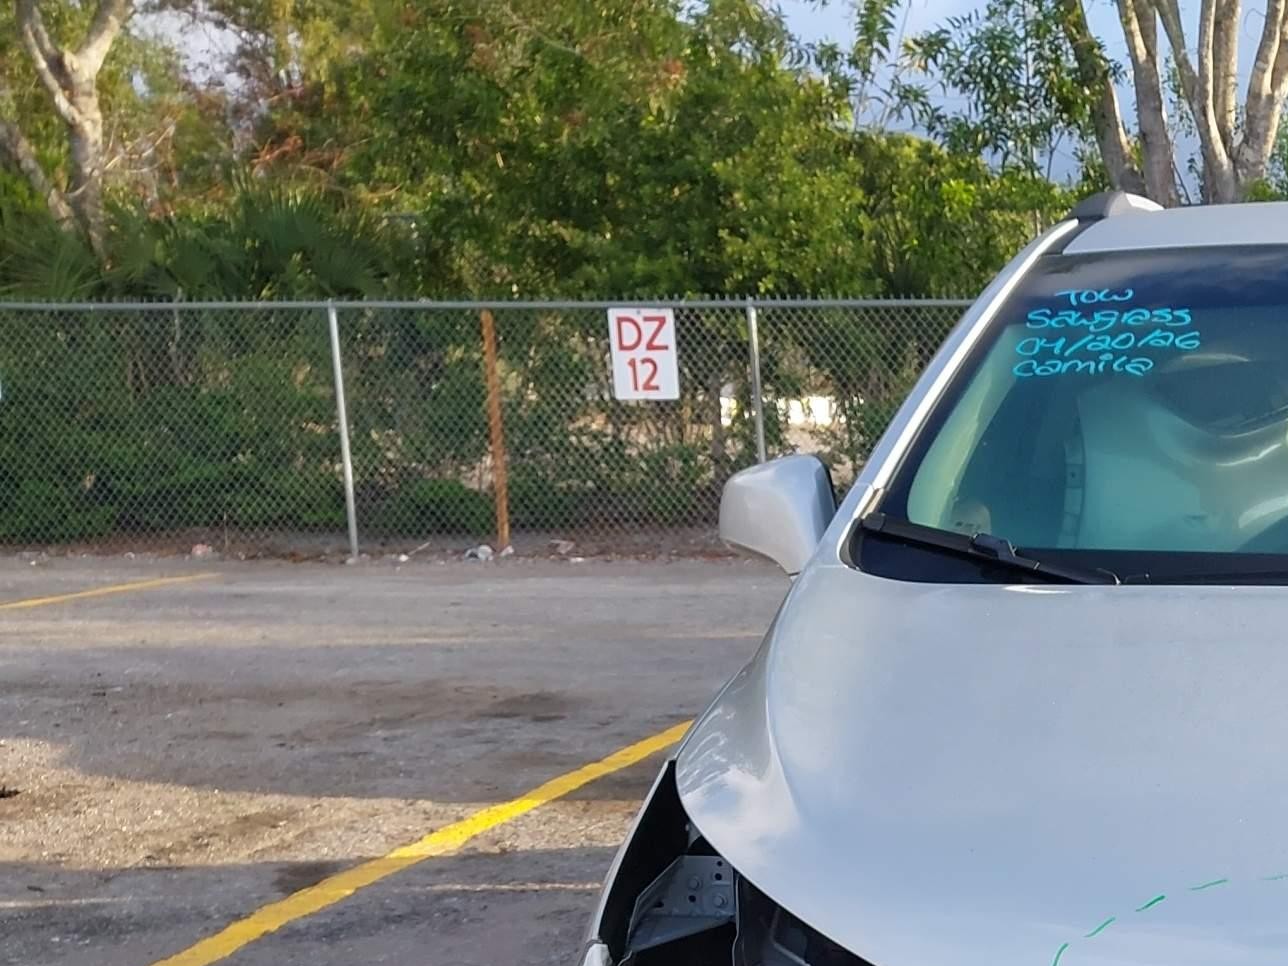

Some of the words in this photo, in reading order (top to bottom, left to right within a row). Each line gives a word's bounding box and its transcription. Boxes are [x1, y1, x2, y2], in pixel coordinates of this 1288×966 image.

[615, 316, 669, 351] DZ
[1015, 329, 1201, 356] 04/20/26
[627, 357, 660, 391] 12
